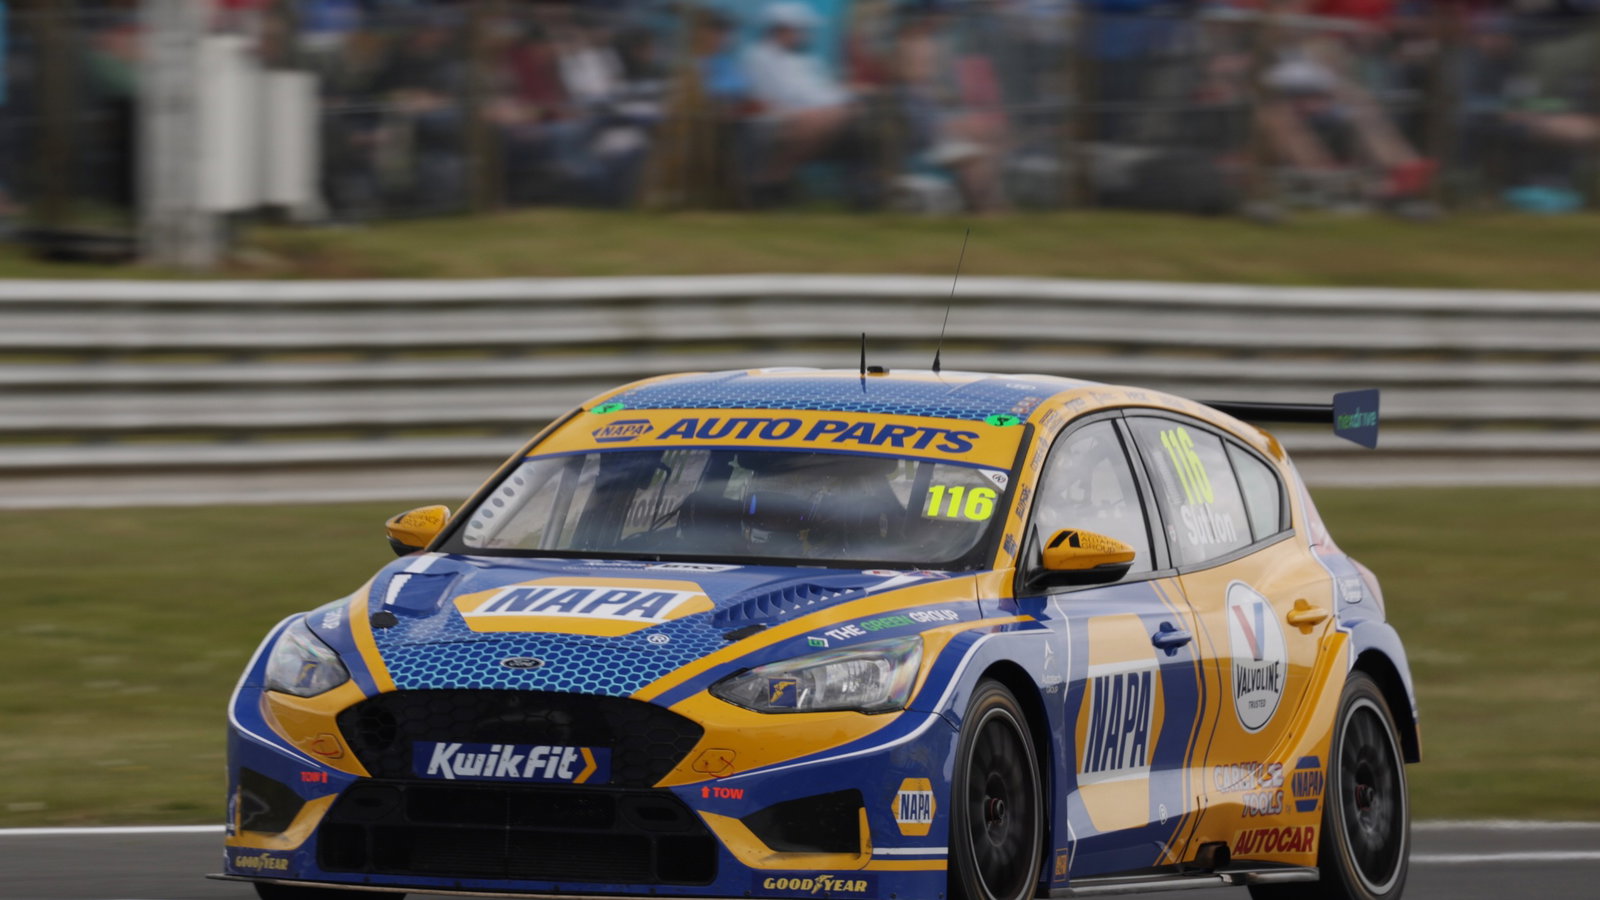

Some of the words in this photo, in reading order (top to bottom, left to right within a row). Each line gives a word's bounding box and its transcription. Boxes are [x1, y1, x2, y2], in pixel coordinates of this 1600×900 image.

[656, 418, 803, 440] AUTO
[803, 420, 980, 453] PARTS
[1160, 427, 1214, 504] 116
[926, 484, 996, 522] 116
[1180, 502, 1238, 546] Sutton
[484, 587, 680, 619] NAPA
[825, 624, 867, 641] THE
[860, 615, 917, 632] GREEN
[909, 609, 960, 623] GROUP
[1236, 660, 1279, 699] VALVOLINE
[1084, 671, 1152, 774] NAPA
[713, 787, 744, 800] TOW
[1294, 771, 1321, 797] NAPA
[900, 793, 931, 821] NAPA
[1242, 790, 1284, 818] TOOLS
[1232, 826, 1315, 856] AUTOCAR
[235, 853, 289, 871] GOODYEAR
[763, 876, 868, 893] GOODYEAR
